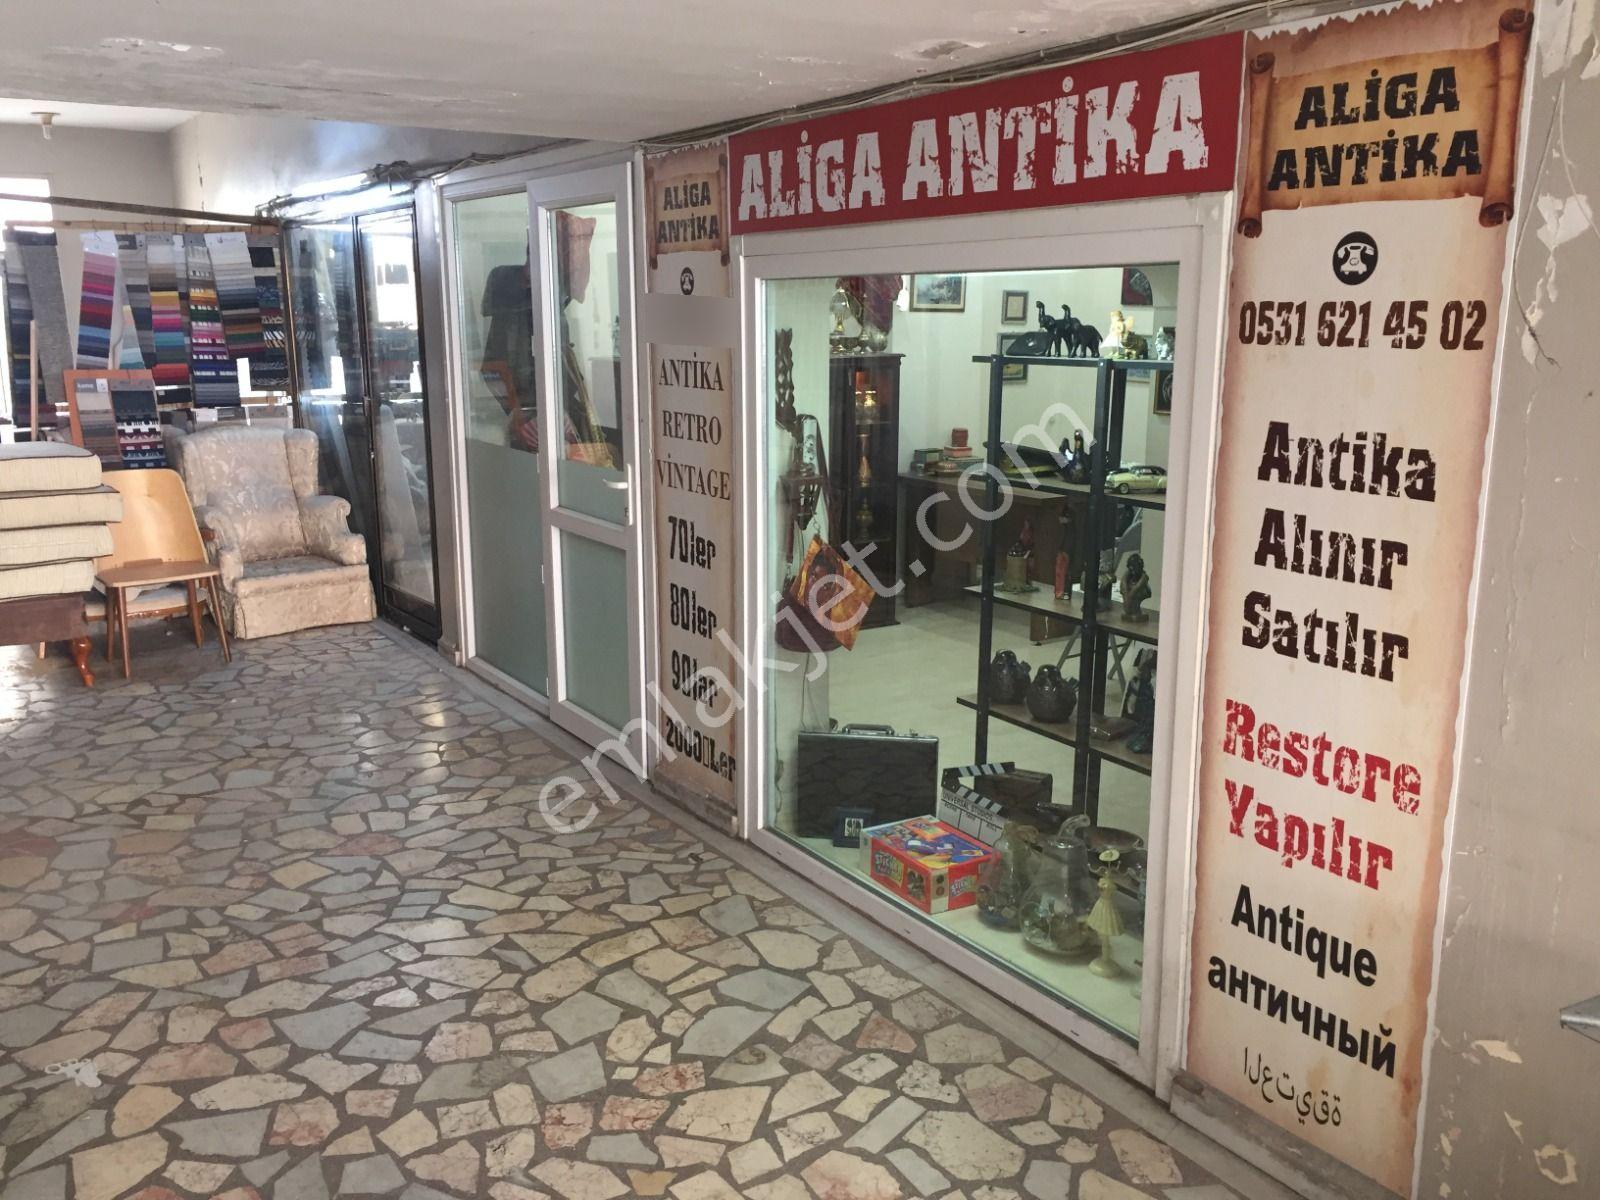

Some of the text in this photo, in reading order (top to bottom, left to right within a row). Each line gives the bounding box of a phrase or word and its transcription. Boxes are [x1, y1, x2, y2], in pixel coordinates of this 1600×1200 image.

[1294, 66, 1460, 130] ALİGA
[738, 70, 1209, 222] ALİGA ANTİKA
[1267, 128, 1482, 191] ANTİKA
[663, 180, 712, 211] ALİGA
[656, 212, 720, 244] ANTİKA
[1238, 300, 1487, 351] 0531 621 45 02
[658, 351, 724, 391] ANTİKA
[662, 409, 722, 446] RETRO
[656, 453, 731, 501] VİNTAGE
[1257, 420, 1437, 502] Antika
[668, 515, 716, 570] 70ler
[1254, 507, 1409, 590] Alınır
[670, 582, 717, 640] 80ler
[1241, 590, 1409, 682] Satılır
[1222, 698, 1422, 816] Restore
[1224, 778, 1393, 891] Yapılır
[1231, 884, 1378, 987] Antique
[1207, 955, 1397, 1079] античный
